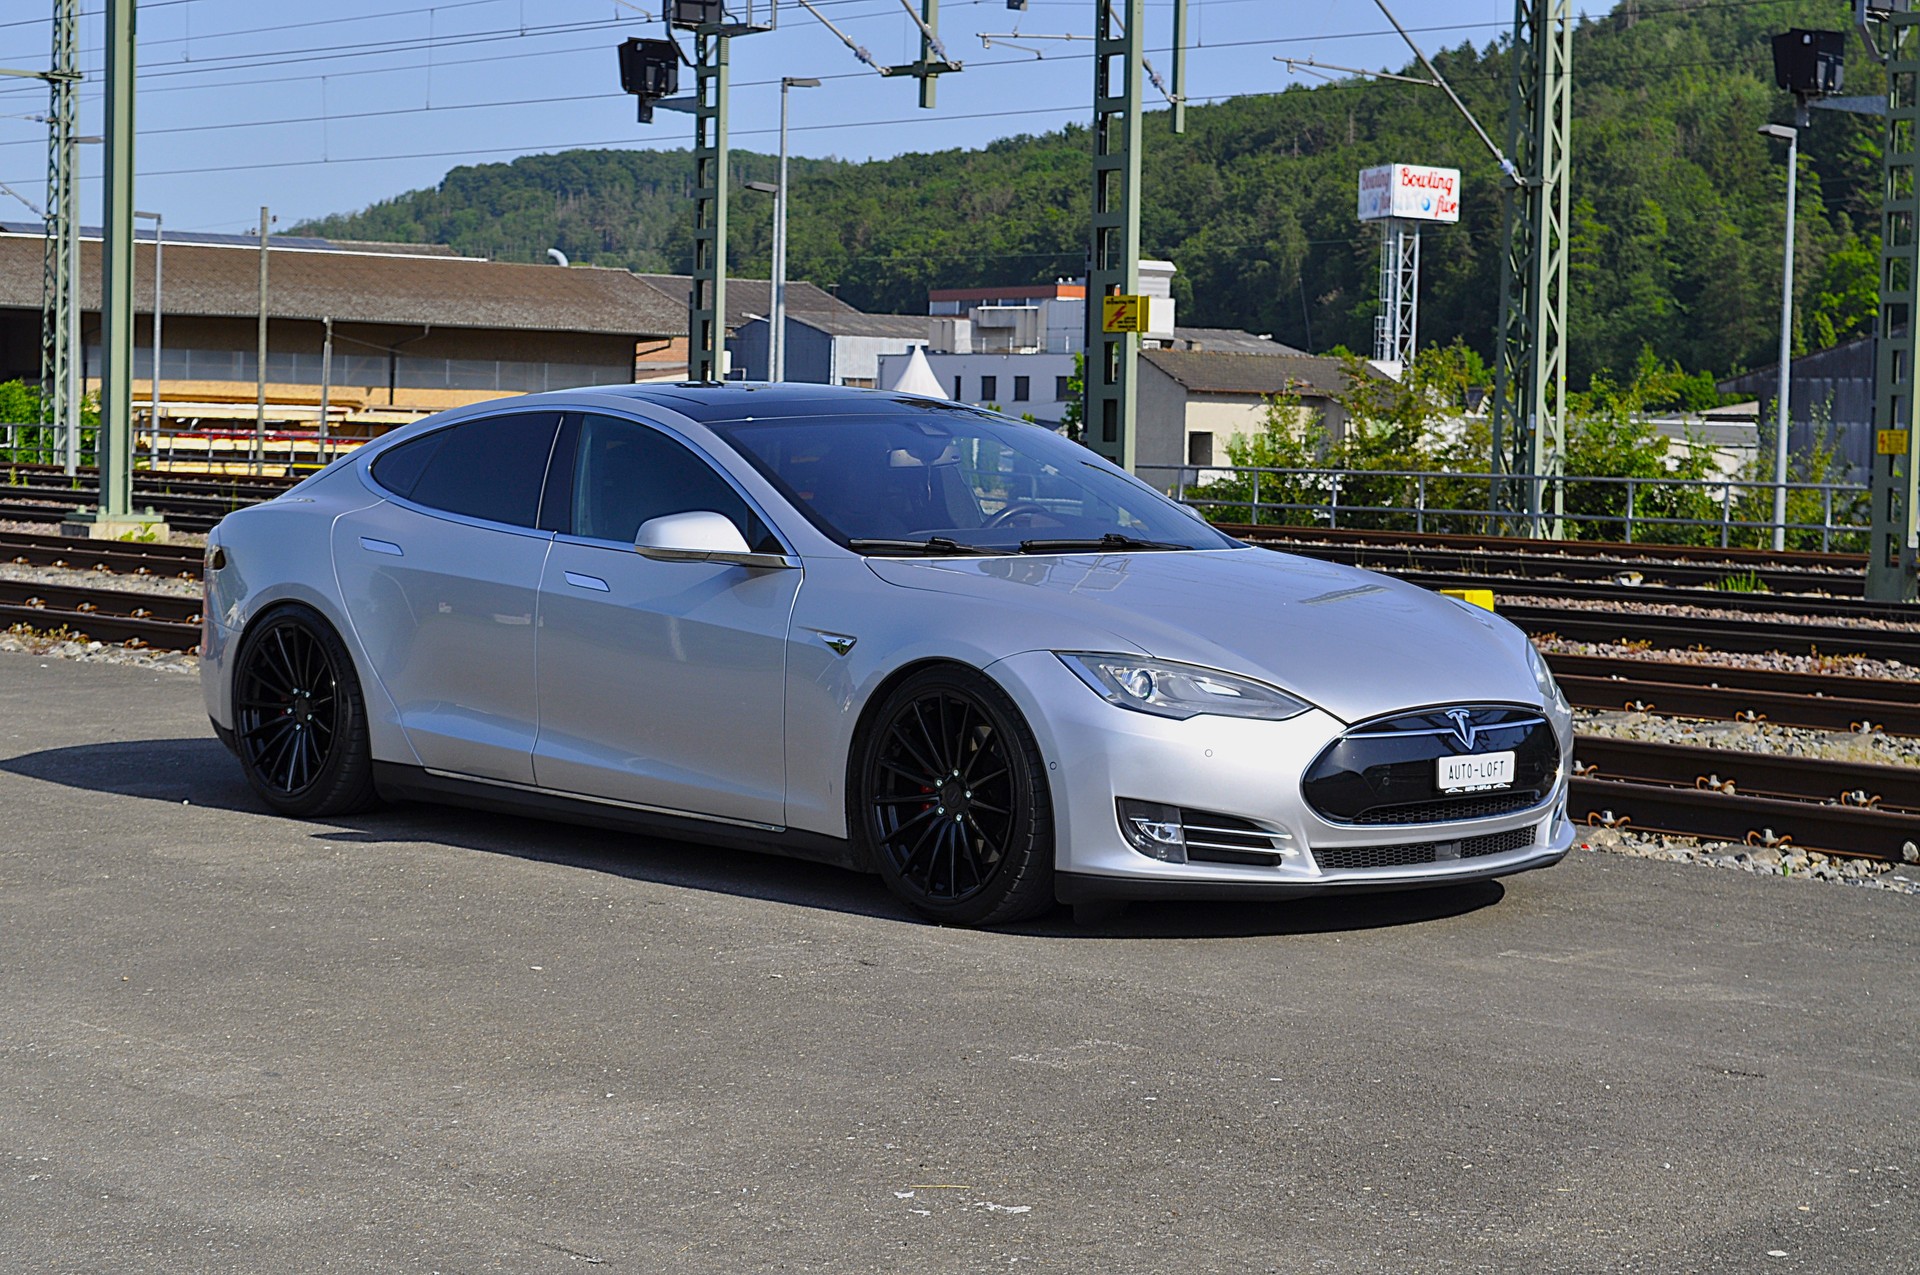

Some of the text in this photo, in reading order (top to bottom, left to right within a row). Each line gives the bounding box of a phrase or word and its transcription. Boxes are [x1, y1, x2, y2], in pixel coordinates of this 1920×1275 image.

[1401, 167, 1453, 196] Bowling
[1434, 194, 1458, 217] five
[1448, 760, 1505, 780] AUTO-LOFT
